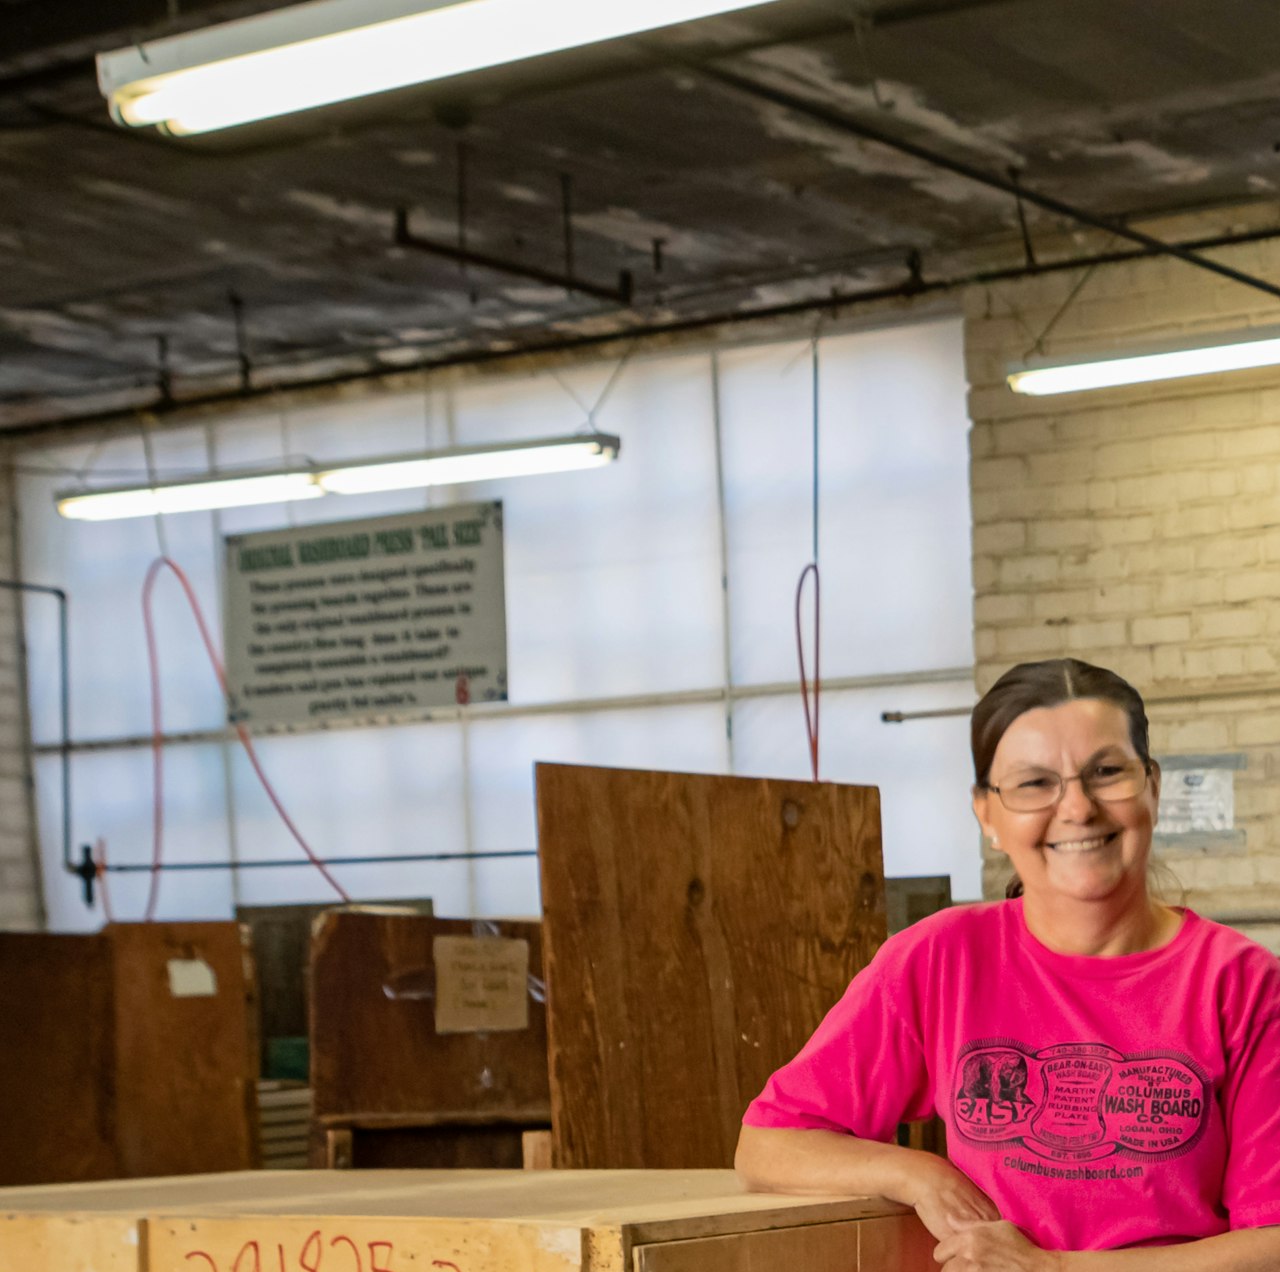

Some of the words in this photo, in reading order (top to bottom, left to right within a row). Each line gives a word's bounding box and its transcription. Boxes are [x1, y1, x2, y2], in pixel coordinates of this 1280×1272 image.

[1118, 1066, 1192, 1084] MANUFACTURED
[1138, 1075, 1173, 1083] SOLELY
[1054, 1085, 1096, 1095] MARTIN
[1118, 1085, 1191, 1099] COLUMBUS
[1054, 1094, 1095, 1104] PATENT
[1048, 1103, 1097, 1113] RUBBING
[1105, 1094, 1145, 1114] WASH
[1151, 1098, 1201, 1118] BOARD
[1054, 1112, 1089, 1120] PLATE
[1159, 1127, 1183, 1135] OHIO
[1148, 1140, 1159, 1148] IN
[1160, 1136, 1180, 1147] USA
[1003, 1156, 1144, 1180] columbuswashboard.com
